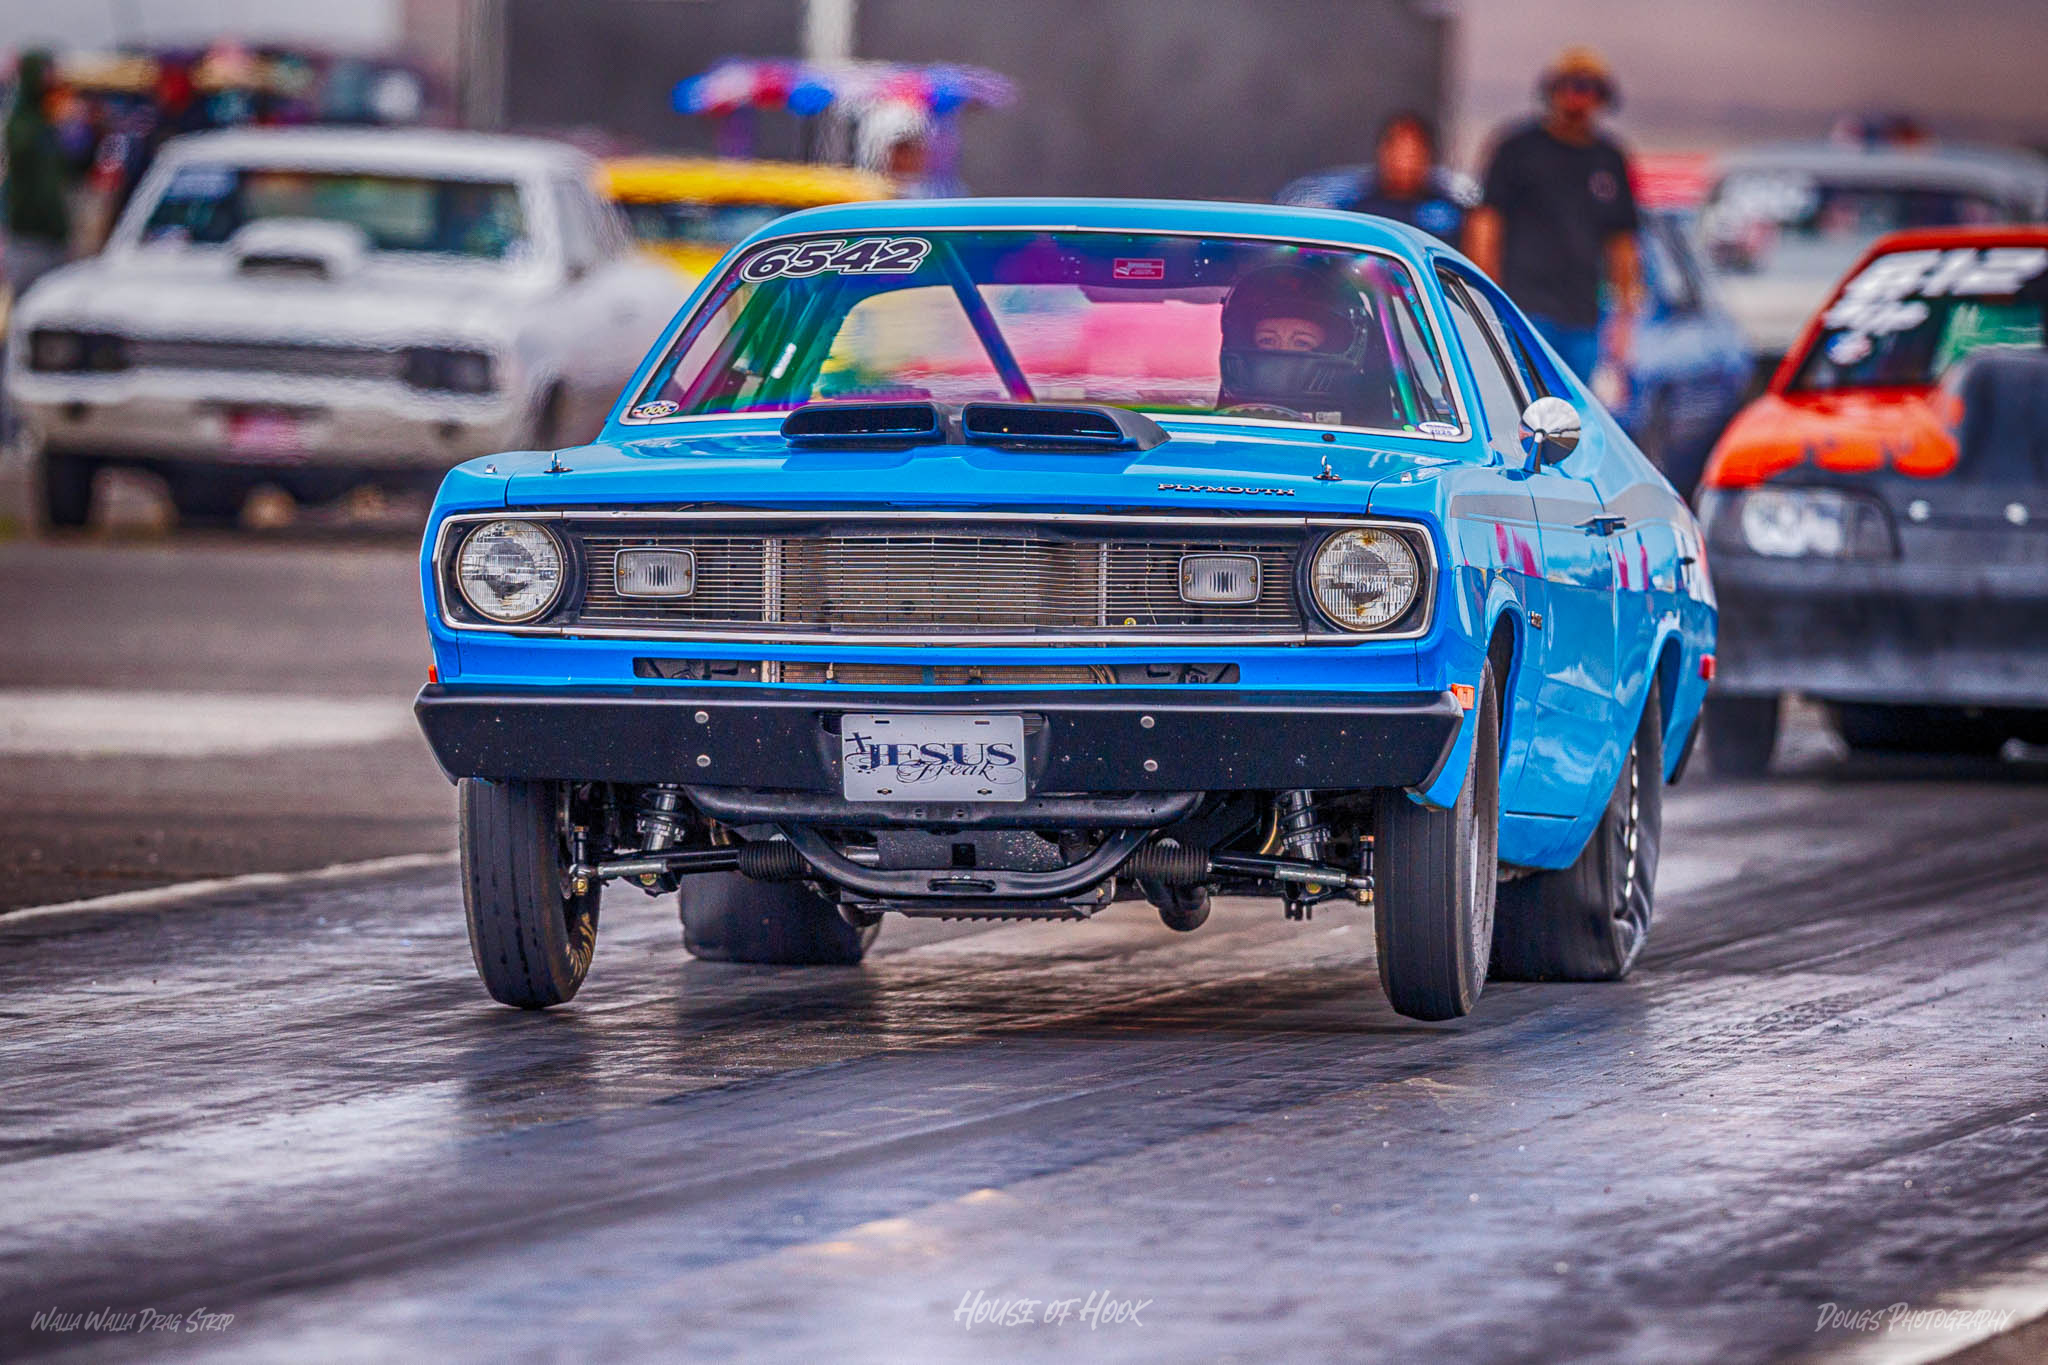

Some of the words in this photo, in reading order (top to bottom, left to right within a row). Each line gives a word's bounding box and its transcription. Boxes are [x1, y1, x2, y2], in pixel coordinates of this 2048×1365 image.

[740, 237, 932, 283] 6542
[1158, 483, 1295, 496] PLYMOUTH
[850, 742, 1017, 768] JESUS
[896, 759, 1023, 785] Freak
